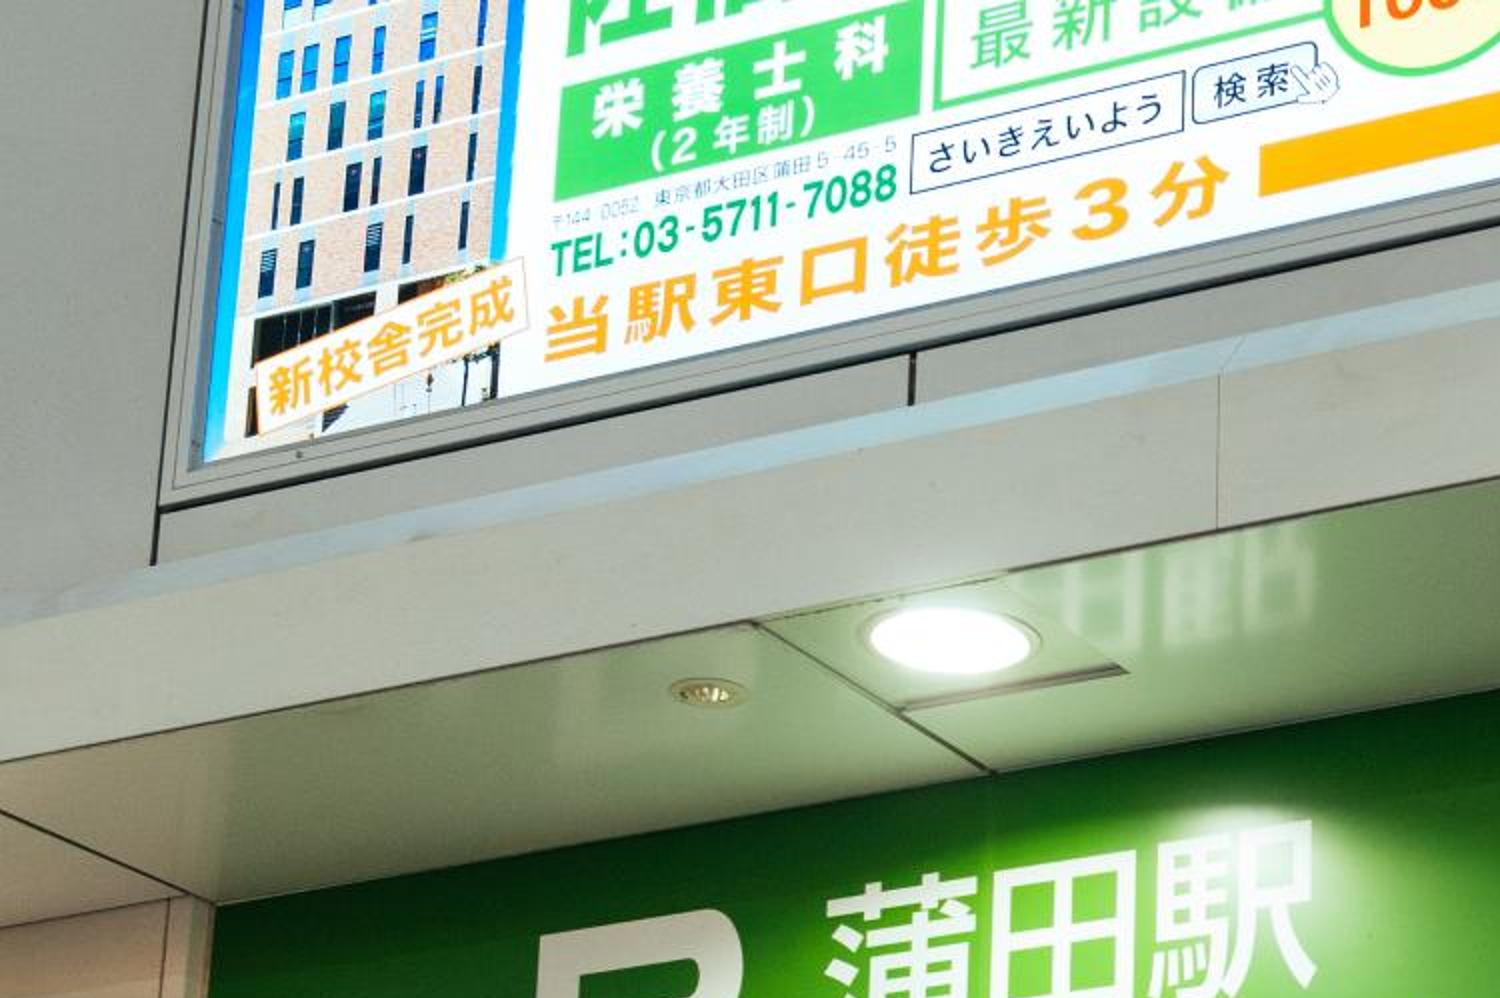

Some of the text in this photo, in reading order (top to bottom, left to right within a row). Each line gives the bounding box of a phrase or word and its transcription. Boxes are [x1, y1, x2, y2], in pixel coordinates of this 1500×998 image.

[592, 16, 889, 138] 栄養士科
[1214, 62, 1290, 109] 検索
[928, 93, 1163, 173] さいきえいよう
[268, 275, 514, 415] 新校舎完成
